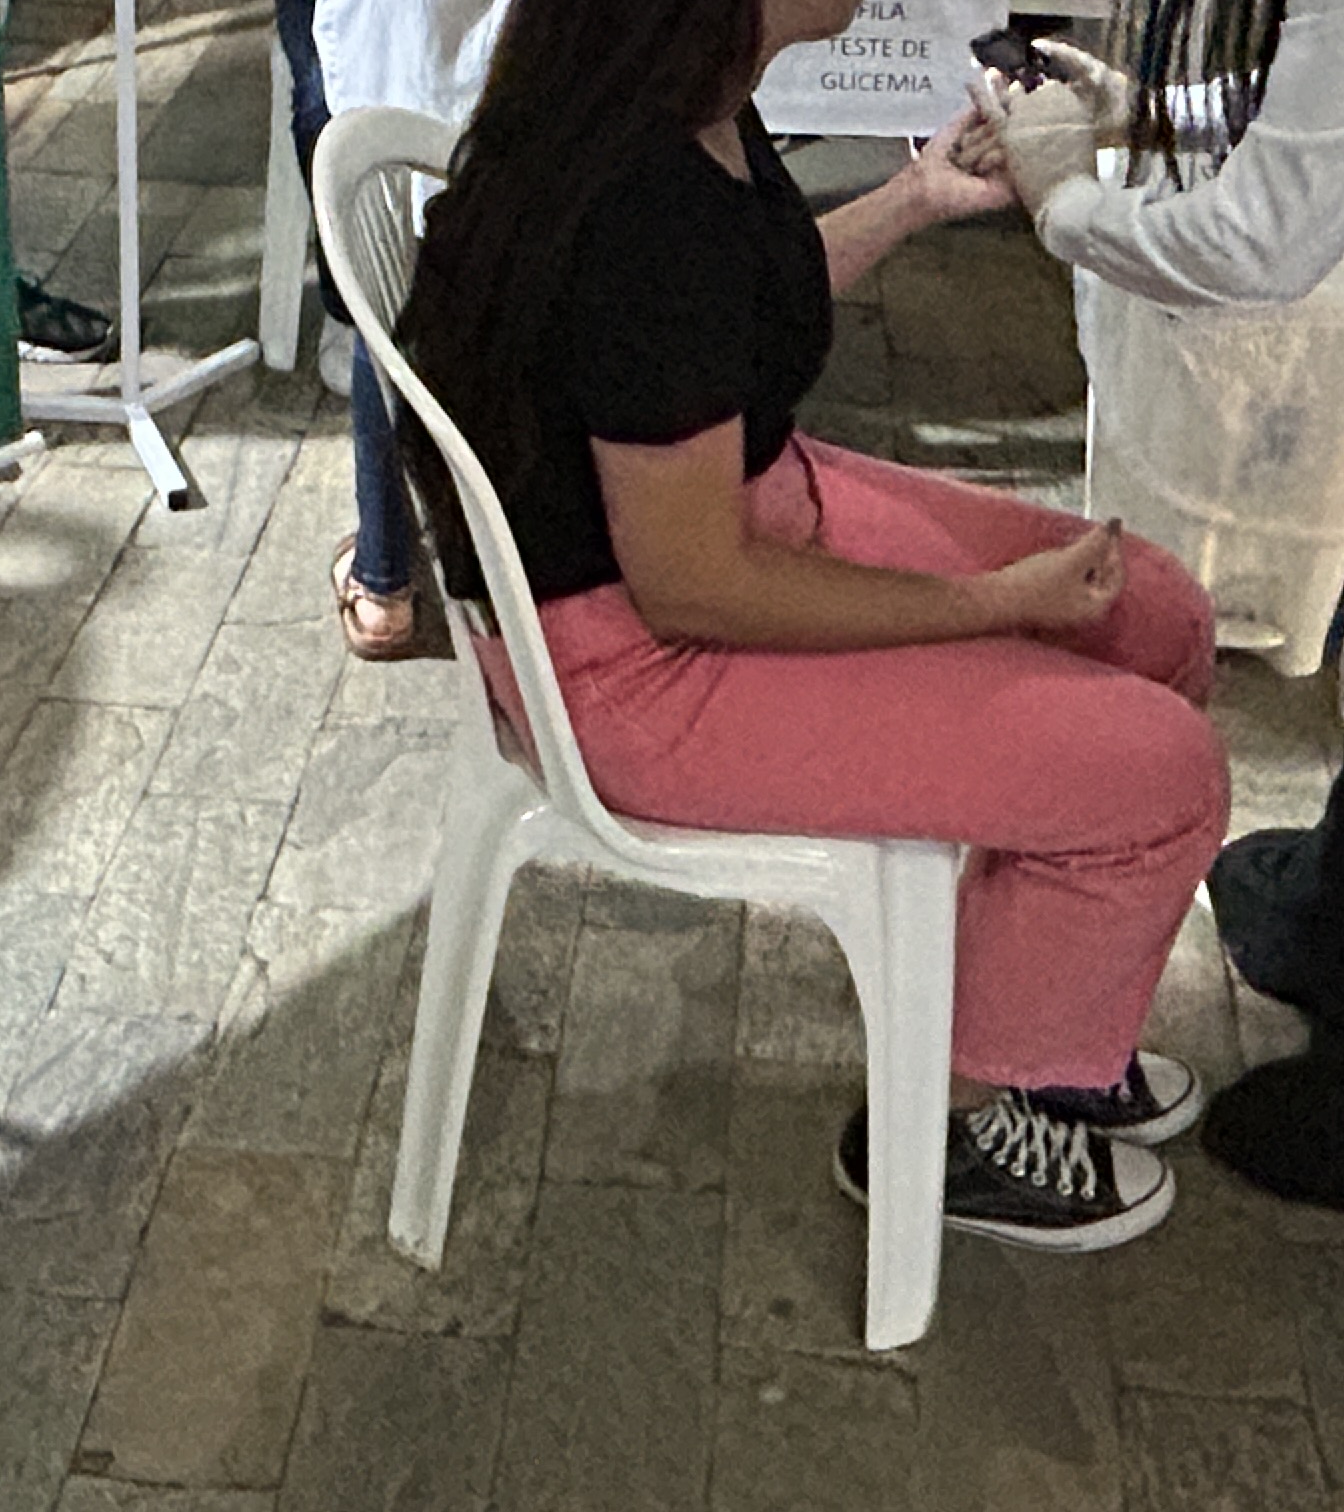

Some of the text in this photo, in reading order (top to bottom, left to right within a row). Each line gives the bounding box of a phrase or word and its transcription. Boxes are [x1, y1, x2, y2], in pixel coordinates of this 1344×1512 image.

[856, 1, 906, 21] FILA
[828, 37, 931, 58] TESTE DE
[820, 72, 933, 92] GLICEMIA
